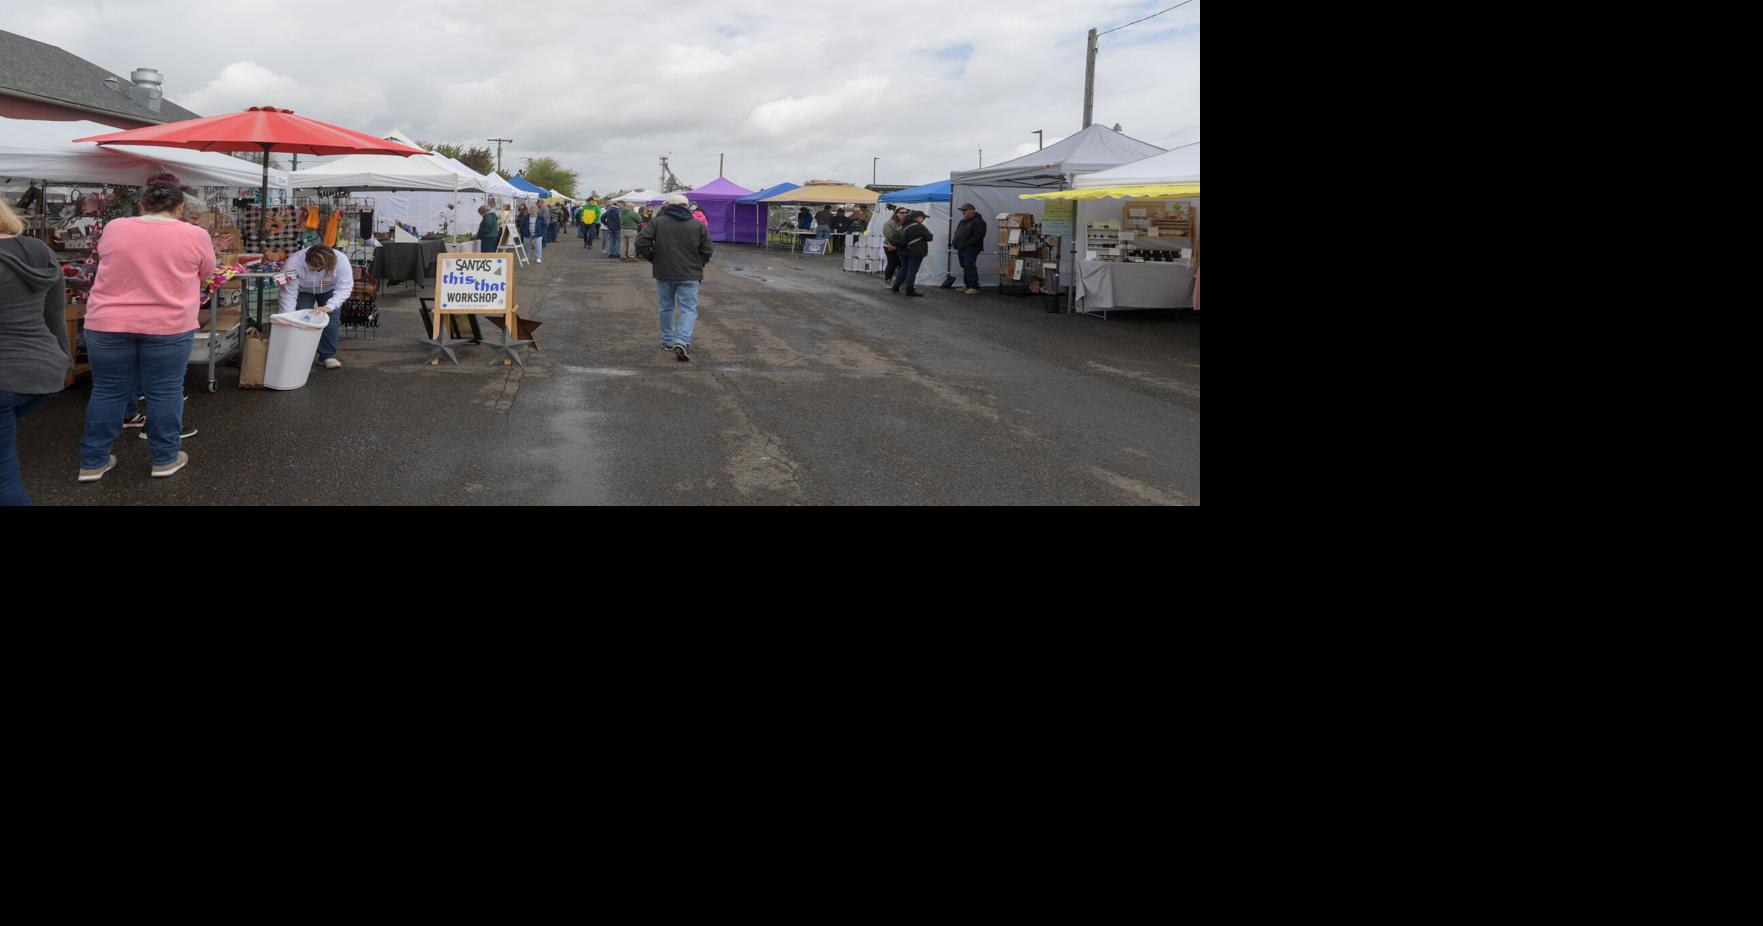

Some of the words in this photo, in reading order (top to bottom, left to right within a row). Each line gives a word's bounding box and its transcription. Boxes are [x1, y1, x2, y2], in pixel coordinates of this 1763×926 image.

[455, 258, 493, 272] SANTA'S
[442, 271, 475, 285] this
[474, 278, 506, 292] that
[447, 292, 498, 303] WORKSHOP
